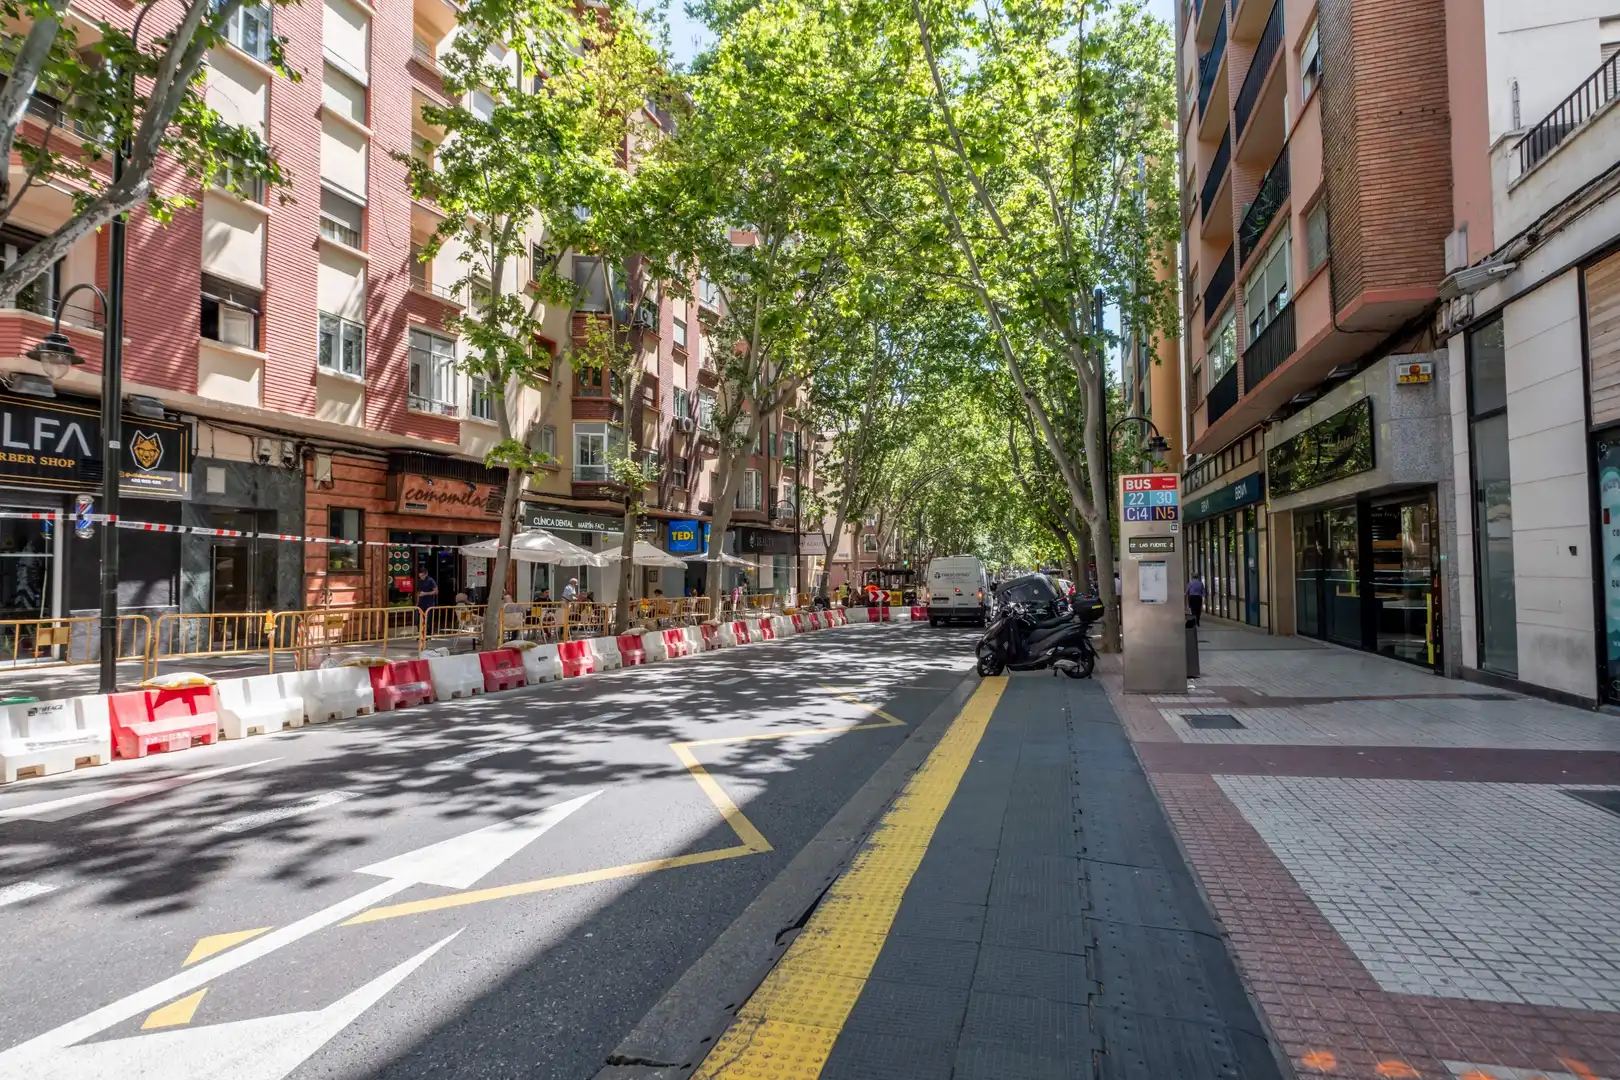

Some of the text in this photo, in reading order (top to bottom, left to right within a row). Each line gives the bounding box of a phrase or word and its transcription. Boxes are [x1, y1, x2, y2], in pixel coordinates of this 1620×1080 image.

[40, 456, 76, 468] SHOP
[1126, 479, 1152, 490] BUS
[1128, 491, 1173, 506] 22 30
[1126, 506, 1175, 521] Ci4 N5
[533, 516, 555, 526] CLÍNICA
[555, 518, 574, 528] DENTAL
